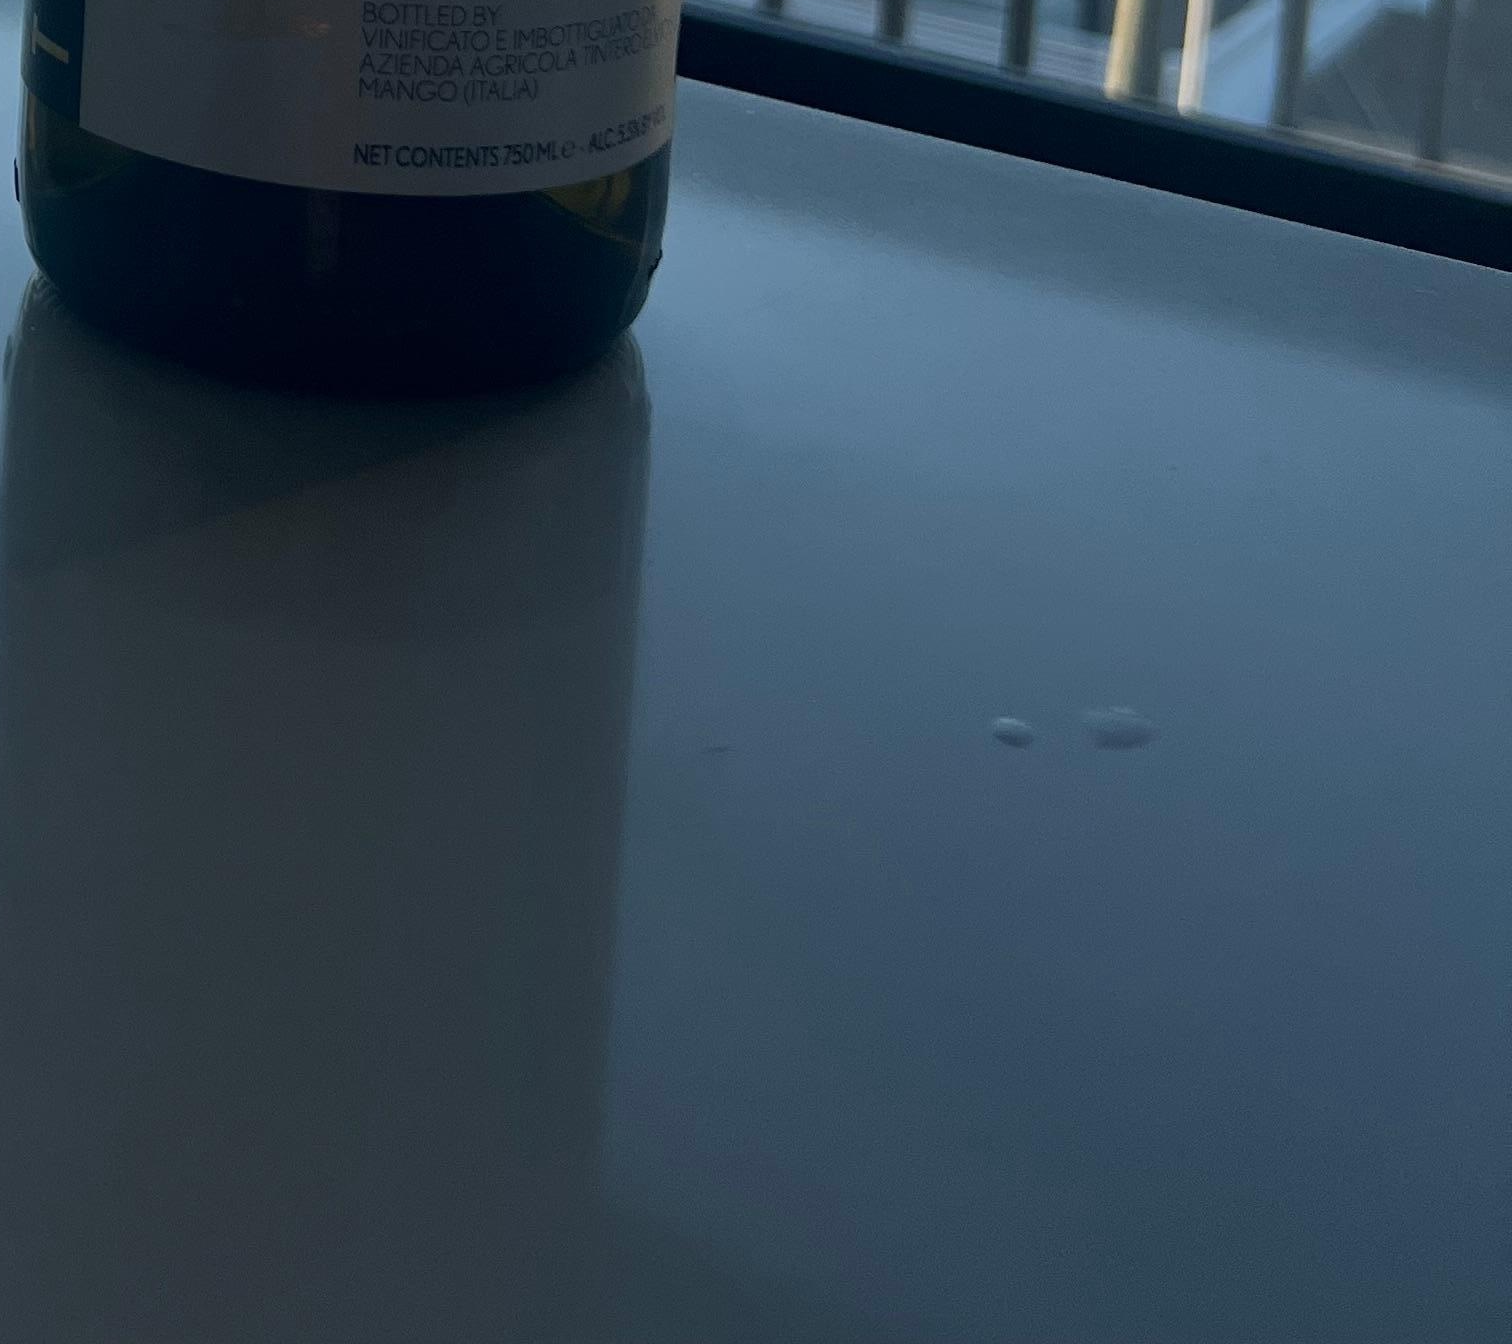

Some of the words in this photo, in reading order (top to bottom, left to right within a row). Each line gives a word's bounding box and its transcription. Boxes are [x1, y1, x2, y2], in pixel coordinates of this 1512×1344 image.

[362, 1, 466, 27] BOTTLED
[471, 4, 502, 28] BY
[361, 27, 490, 54] VINIFICATO
[495, 29, 508, 52] E
[359, 52, 466, 80] AZIENDA
[472, 49, 578, 80] AGRICOLA
[358, 78, 458, 104] MANGO
[463, 79, 539, 106] (ITALIA)
[352, 143, 392, 168] NET
[395, 144, 500, 170] CONTENTS
[503, 143, 537, 168] 750
